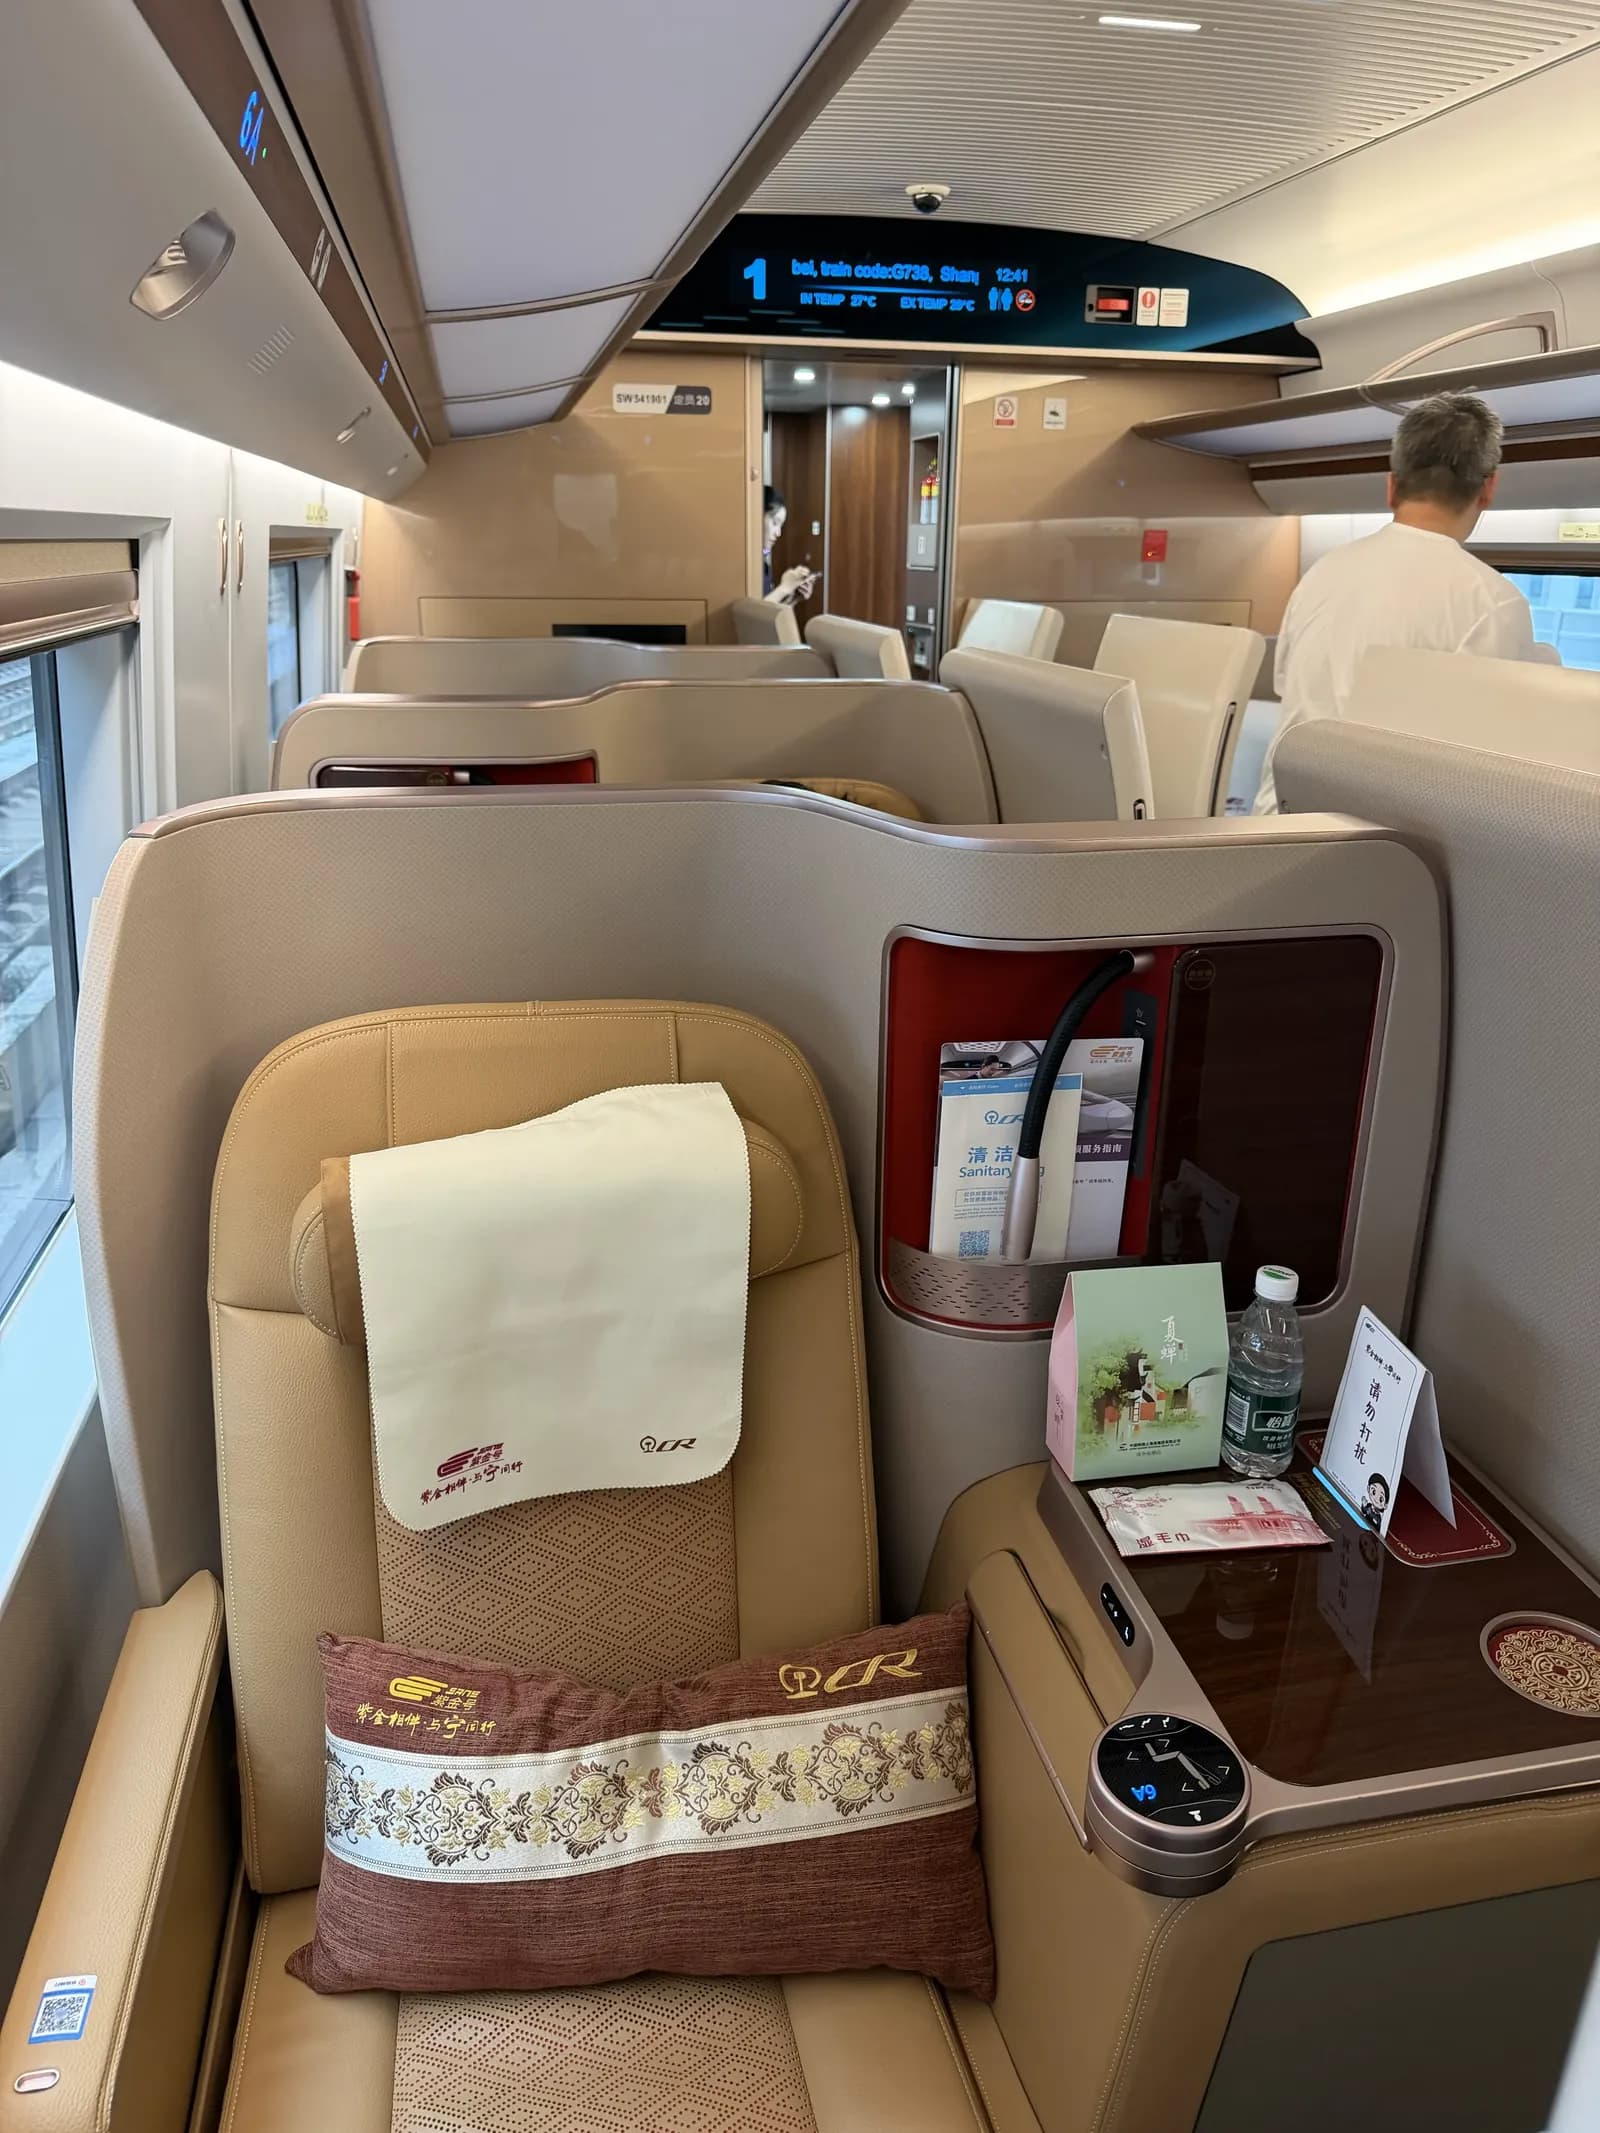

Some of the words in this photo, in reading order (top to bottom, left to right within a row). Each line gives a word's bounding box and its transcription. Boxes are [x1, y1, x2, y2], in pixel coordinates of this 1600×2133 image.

[820, 261, 852, 277] train
[996, 268, 1028, 283] 12:41
[744, 258, 766, 300] 1
[814, 293, 845, 306] TEMP
[917, 297, 948, 310] TEMP
[959, 1165, 1013, 1179] Sanitary
[1353, 1378, 1381, 1465] 请勿打扰
[1136, 1531, 1191, 1550] 湿毛巾
[1130, 1784, 1157, 1803] 6A
